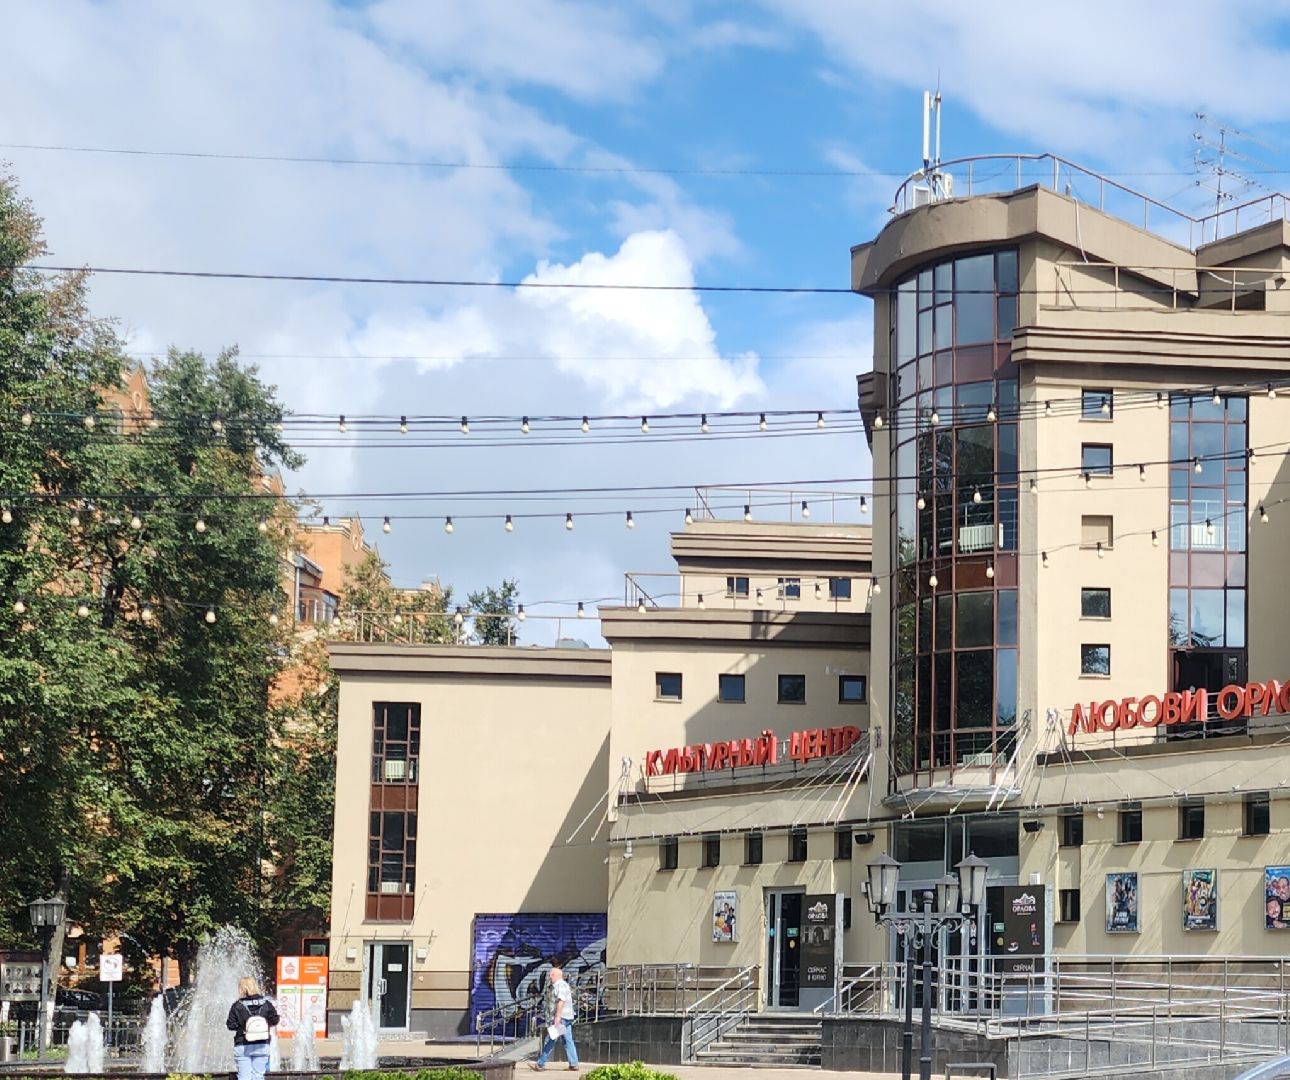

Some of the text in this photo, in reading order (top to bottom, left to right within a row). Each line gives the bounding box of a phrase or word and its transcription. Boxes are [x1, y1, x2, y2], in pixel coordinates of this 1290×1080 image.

[1069, 688, 1207, 735] ЛЮБОВИ
[645, 725, 861, 776] КУЛЬТУРНЫЙ ЦЕНТР
[1013, 964, 1034, 972] СЕЙЧА
